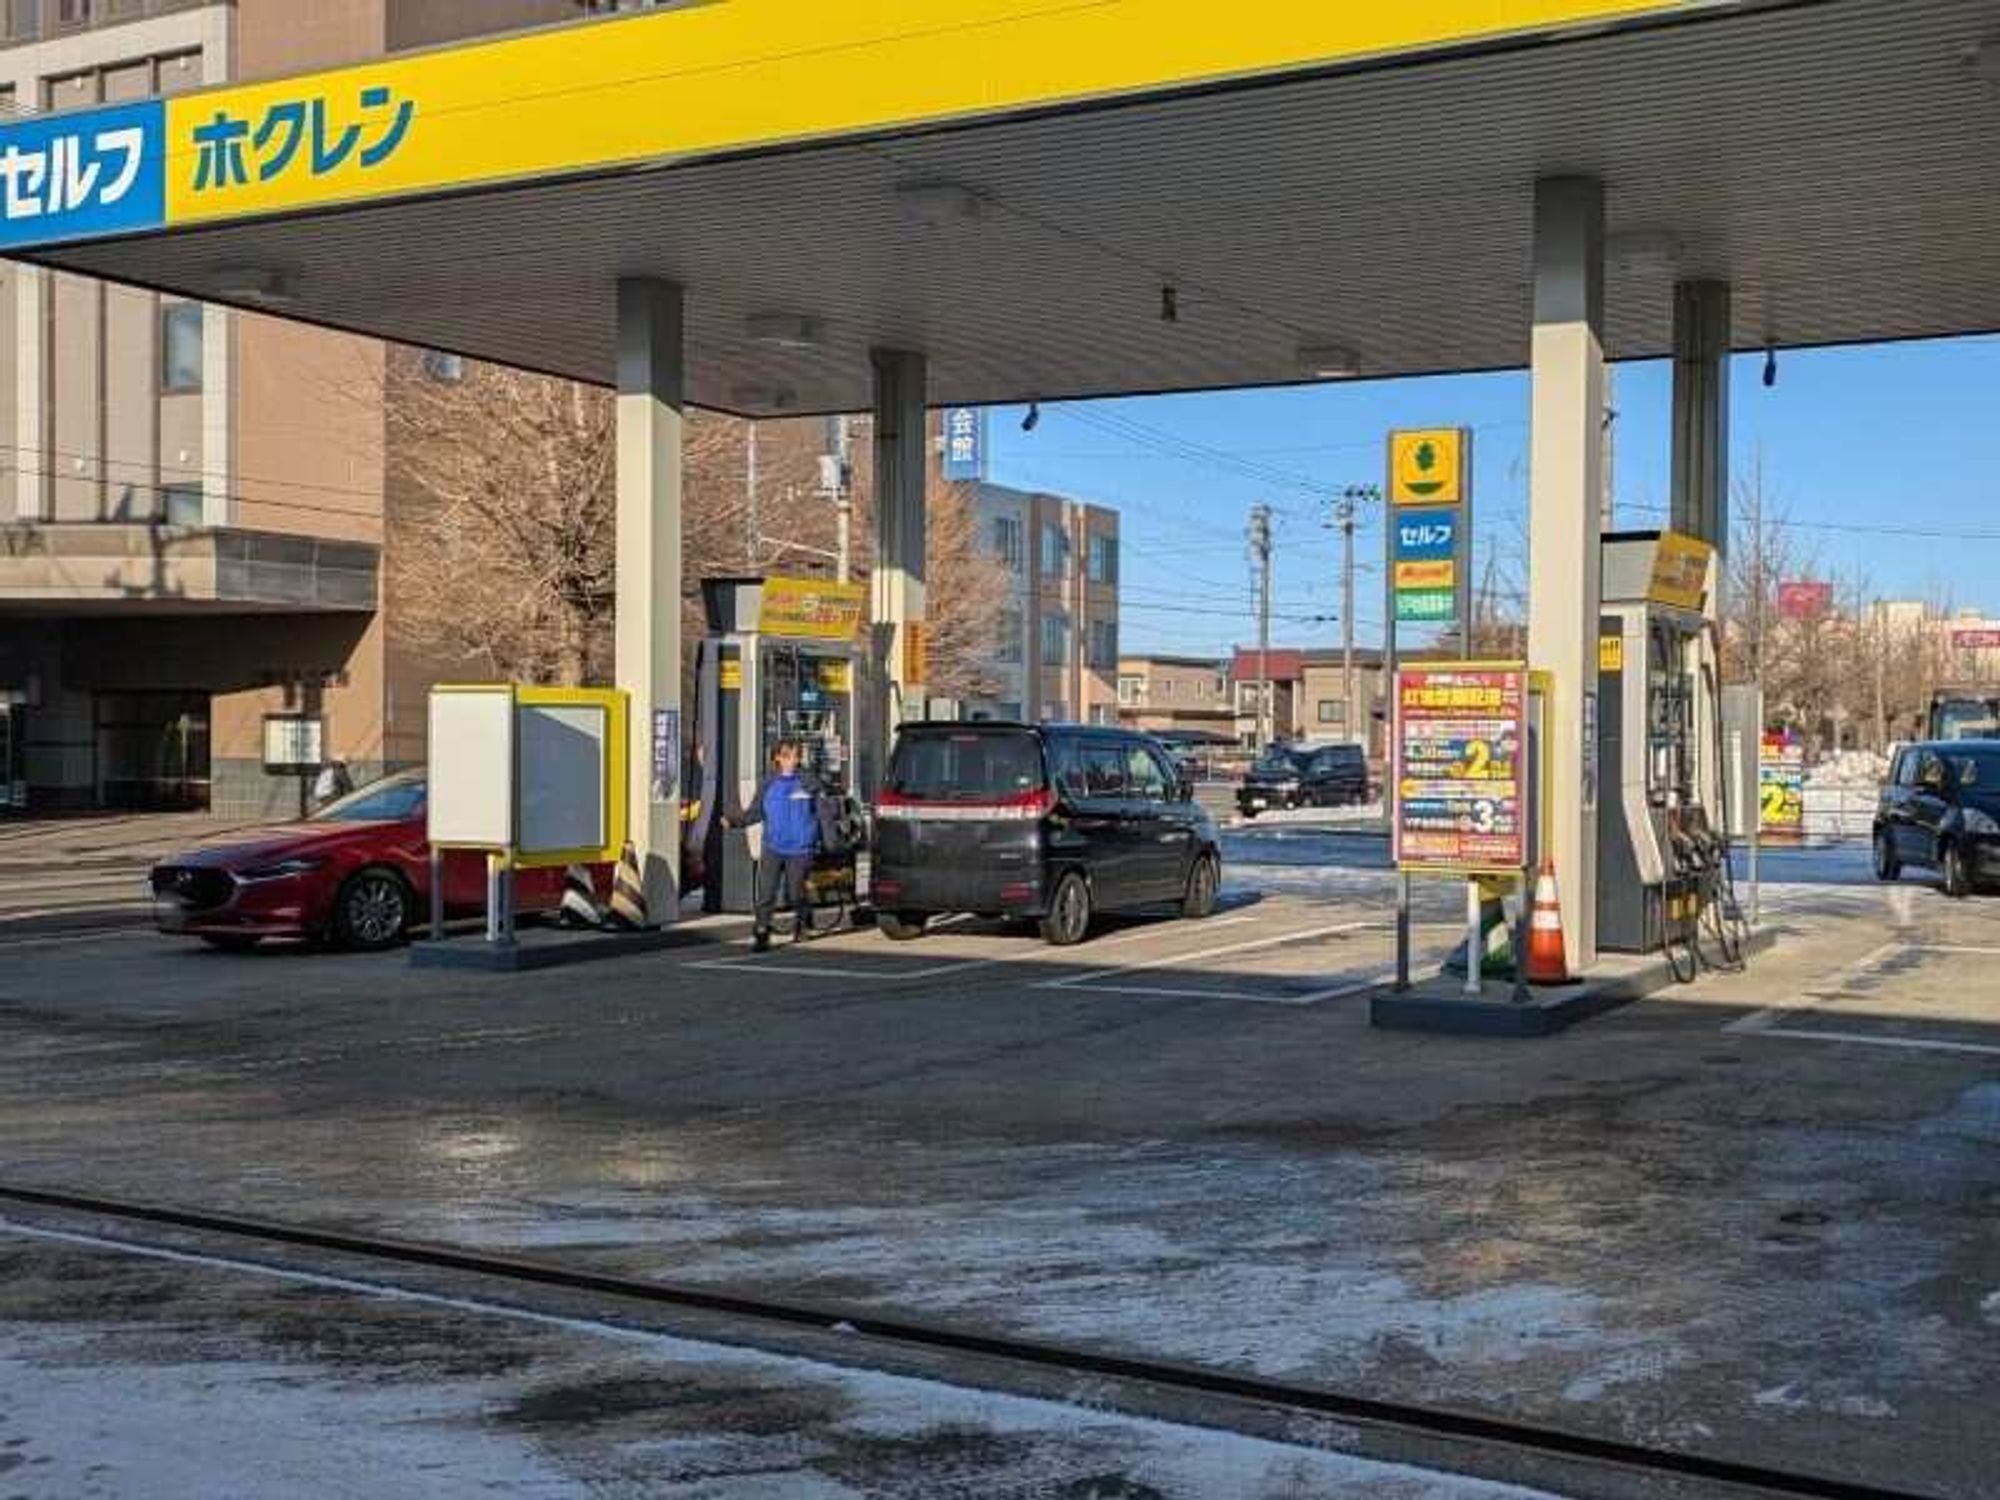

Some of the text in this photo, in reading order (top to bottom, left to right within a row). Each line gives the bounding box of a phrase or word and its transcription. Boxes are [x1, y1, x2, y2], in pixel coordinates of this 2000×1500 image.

[0, 127, 144, 219] セルフ
[192, 86, 414, 191] ホクレン
[1399, 524, 1452, 546] セルフ
